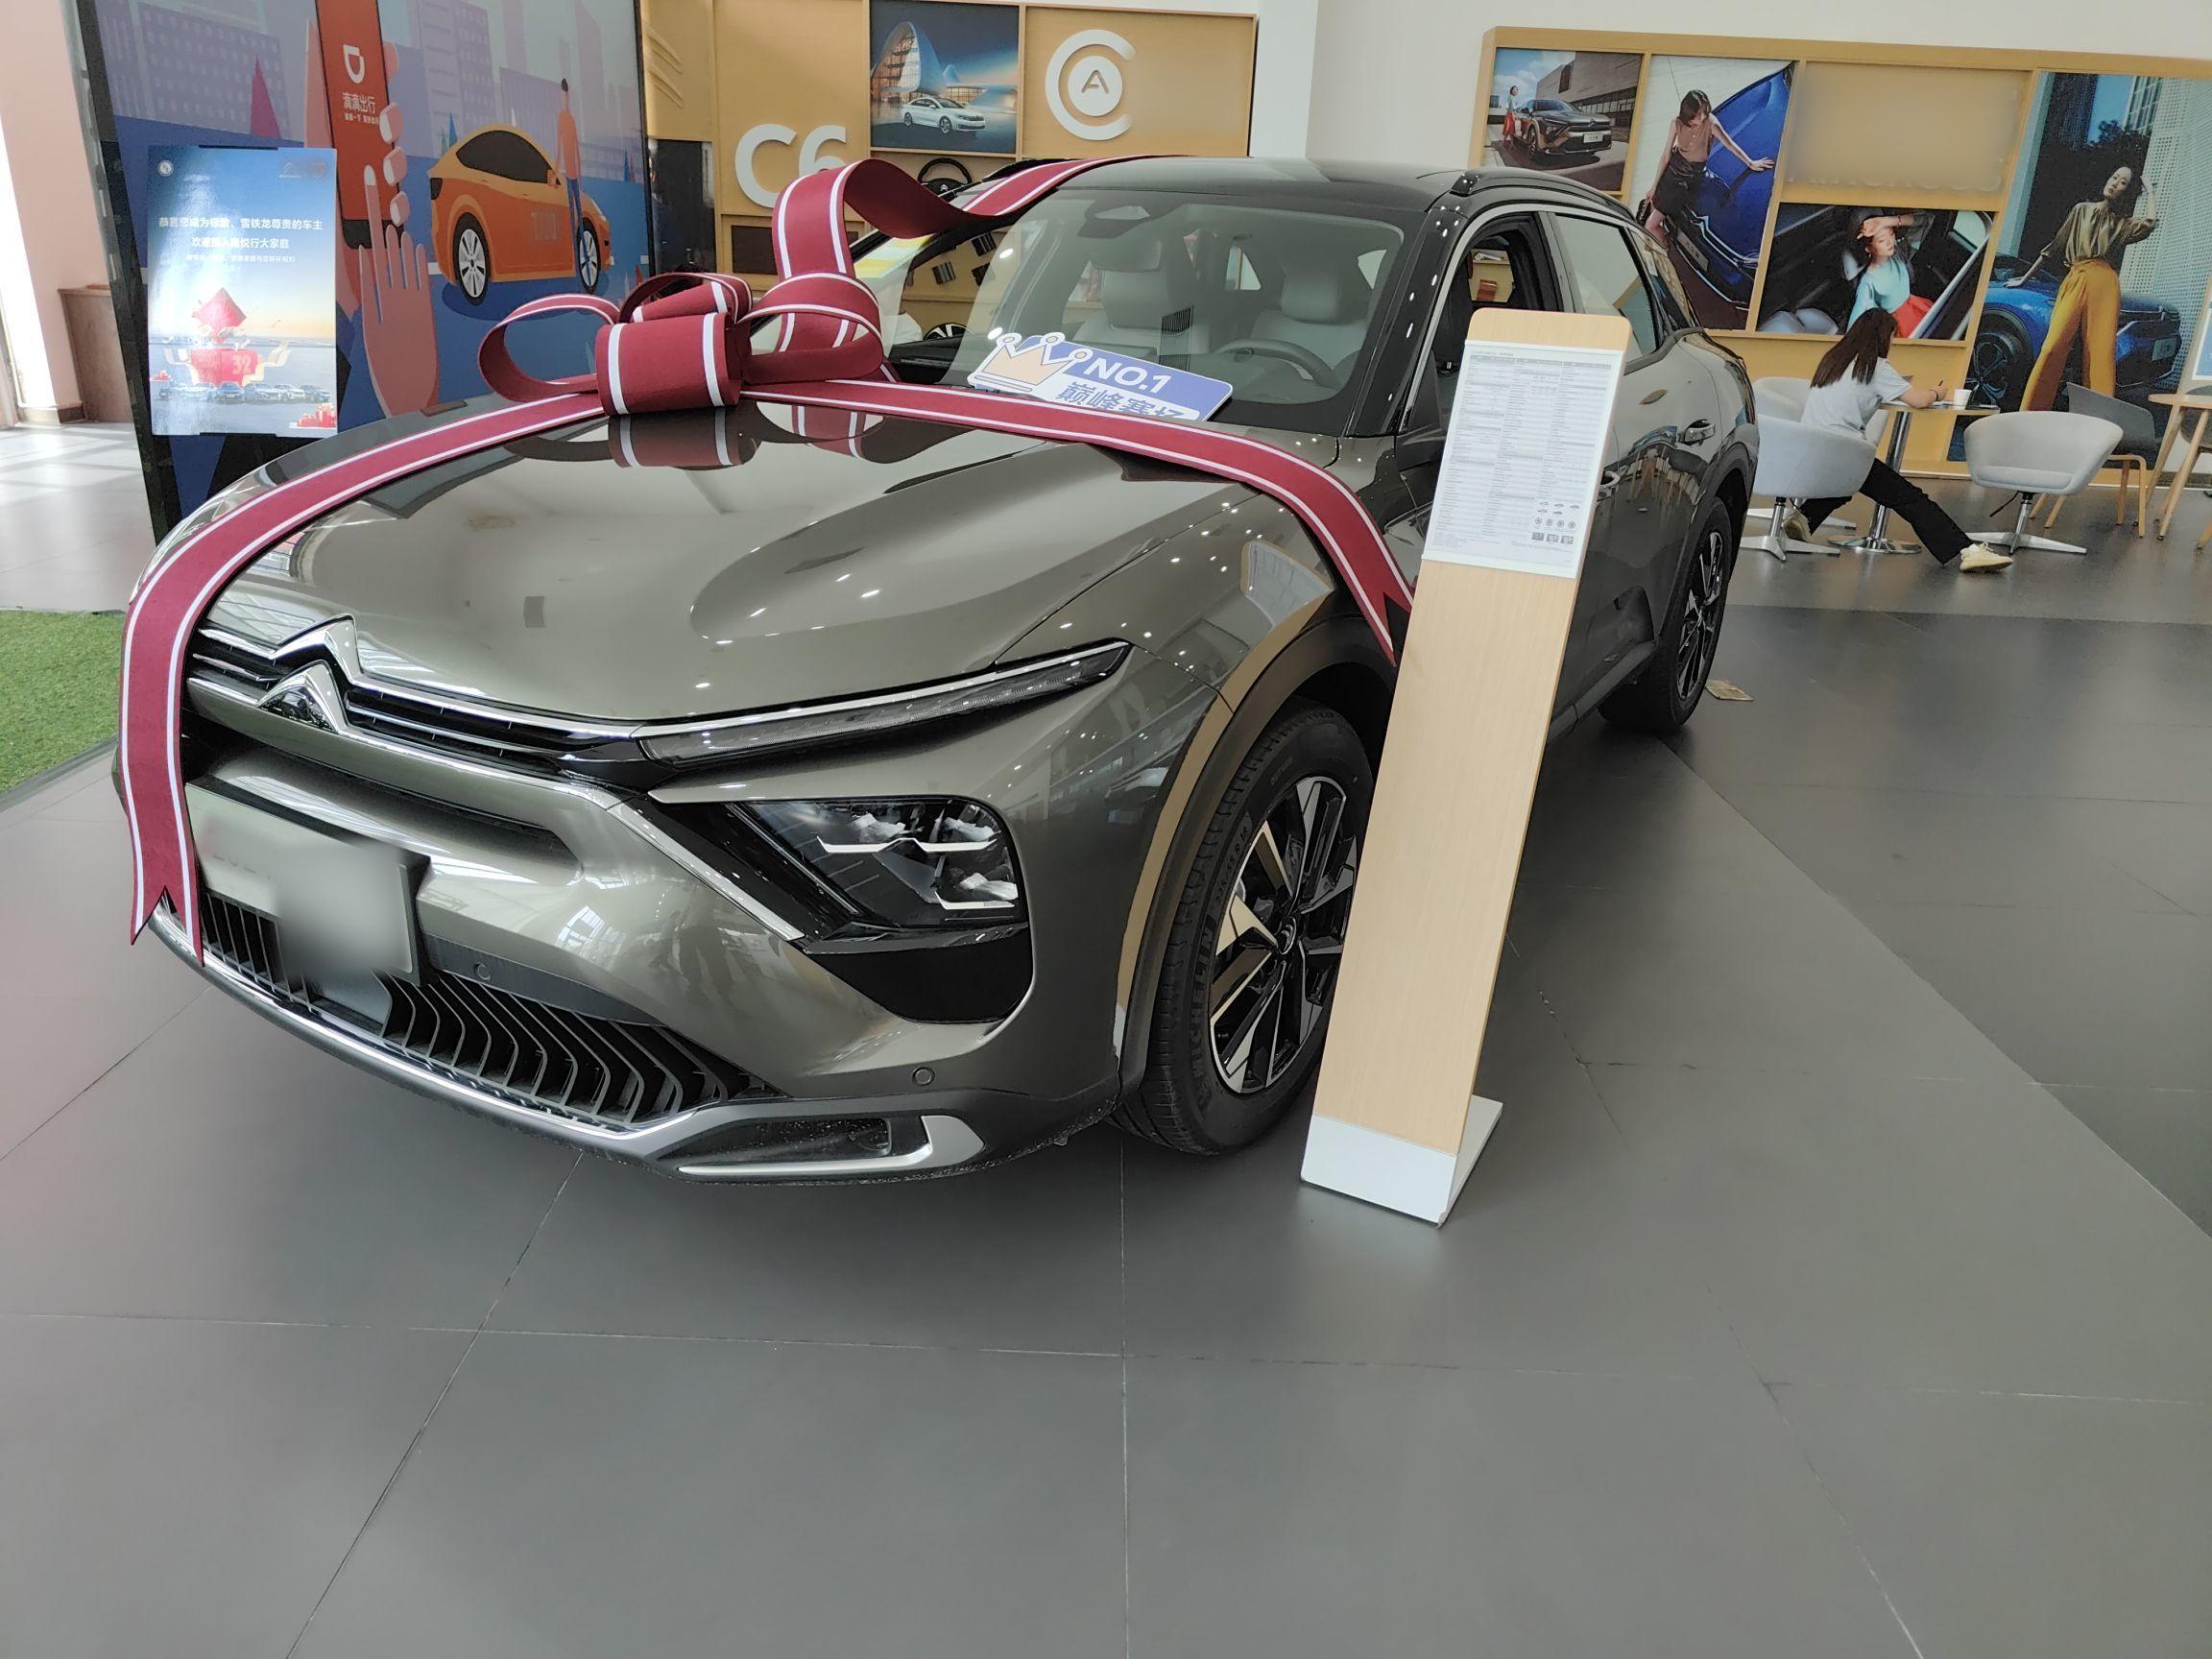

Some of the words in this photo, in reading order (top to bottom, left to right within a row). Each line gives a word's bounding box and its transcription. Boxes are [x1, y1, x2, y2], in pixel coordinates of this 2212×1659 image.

[342, 91, 376, 114] 滴滴出行
[734, 123, 847, 208] C6
[231, 354, 252, 375] 32
[1083, 357, 1172, 395] NO.1
[1190, 923, 1214, 1079] MICHELIN
